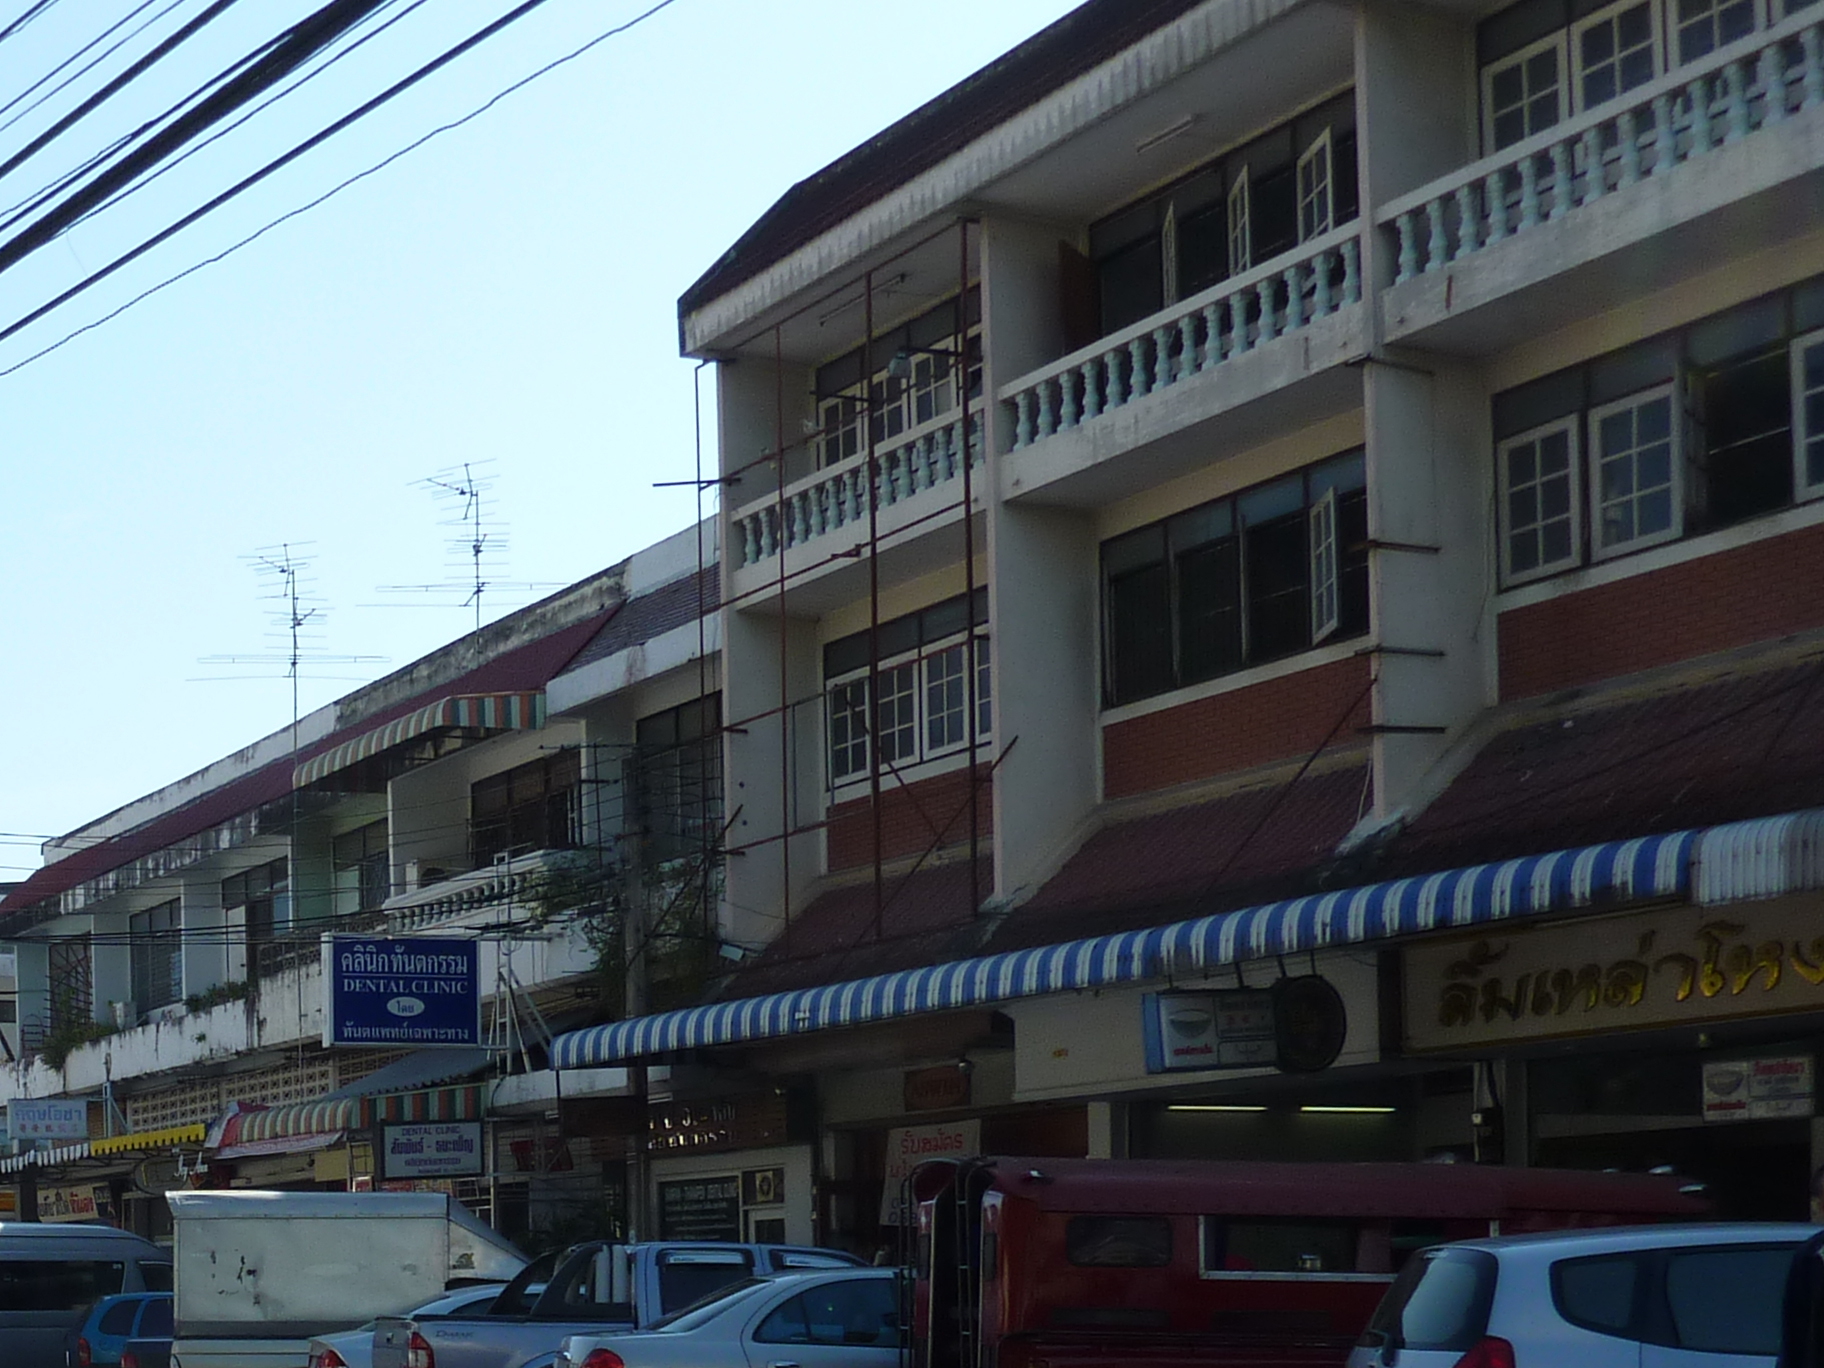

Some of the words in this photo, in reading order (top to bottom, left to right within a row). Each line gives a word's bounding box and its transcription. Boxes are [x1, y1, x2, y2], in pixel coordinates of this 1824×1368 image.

[343, 978, 409, 993] DENTAL
[412, 980, 468, 994] CLINIC
[395, 1000, 415, 1014] โดย
[343, 1020, 469, 1040] ทันตแพทย์เฉพาะทาง
[402, 1127, 432, 1136] DENTAL
[435, 1126, 461, 1135] CLINIC
